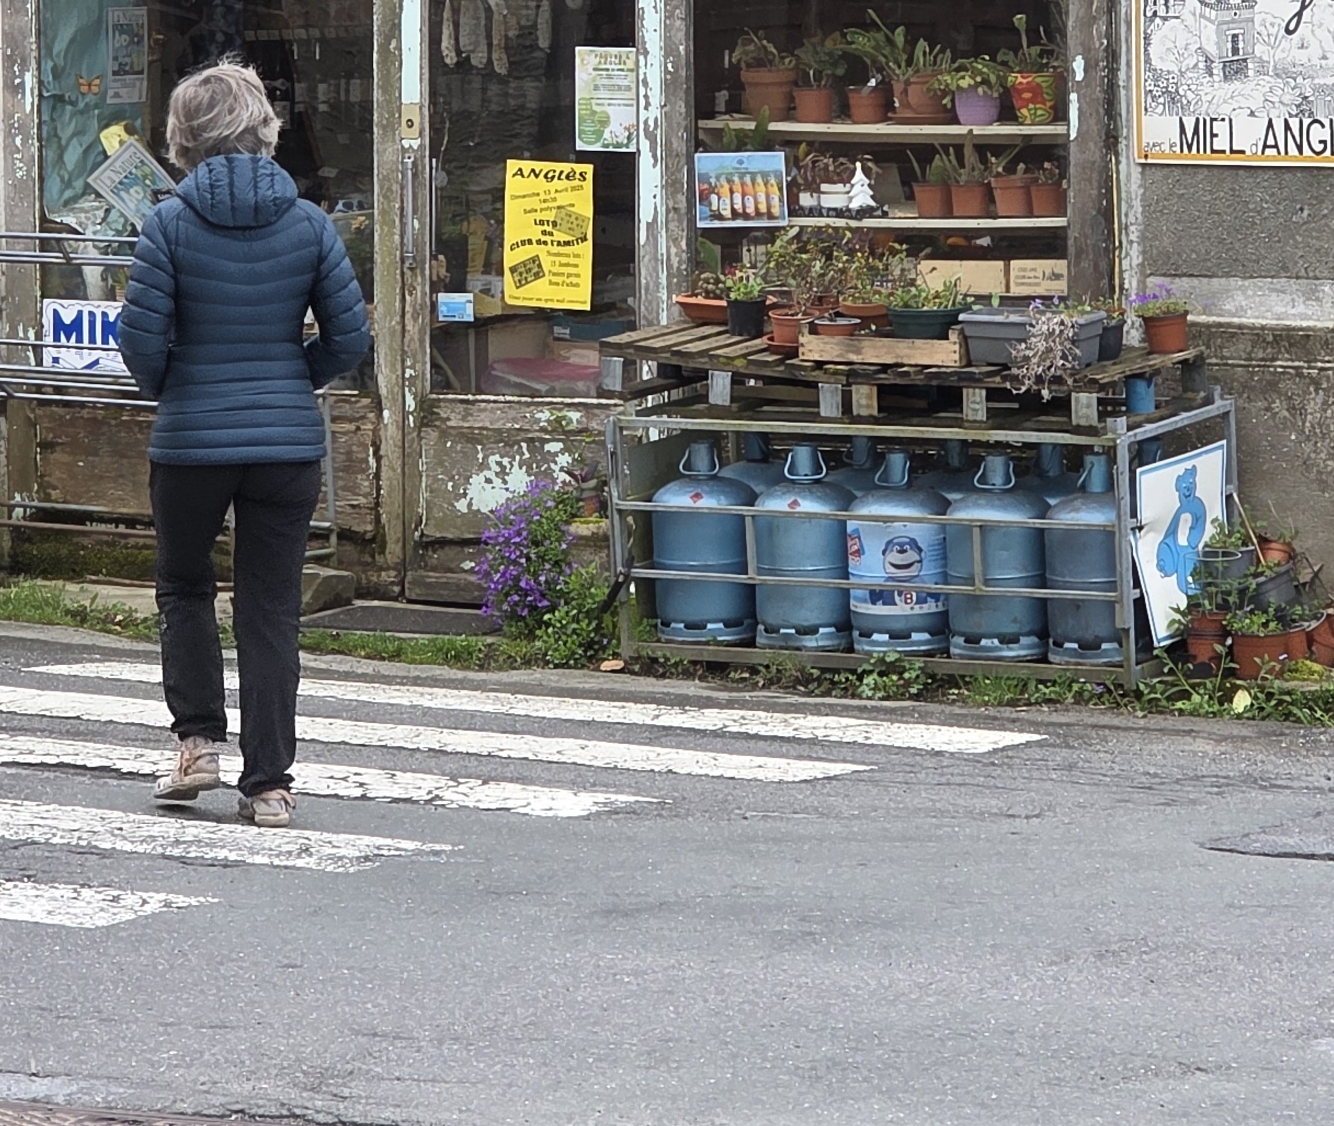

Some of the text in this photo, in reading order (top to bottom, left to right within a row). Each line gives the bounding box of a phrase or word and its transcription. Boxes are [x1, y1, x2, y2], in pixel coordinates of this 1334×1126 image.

[1143, 141, 1166, 153] avec
[1168, 137, 1178, 153] le
[1179, 117, 1246, 155] MIEL
[109, 151, 142, 179] Nature
[534, 218, 558, 229] LOTO
